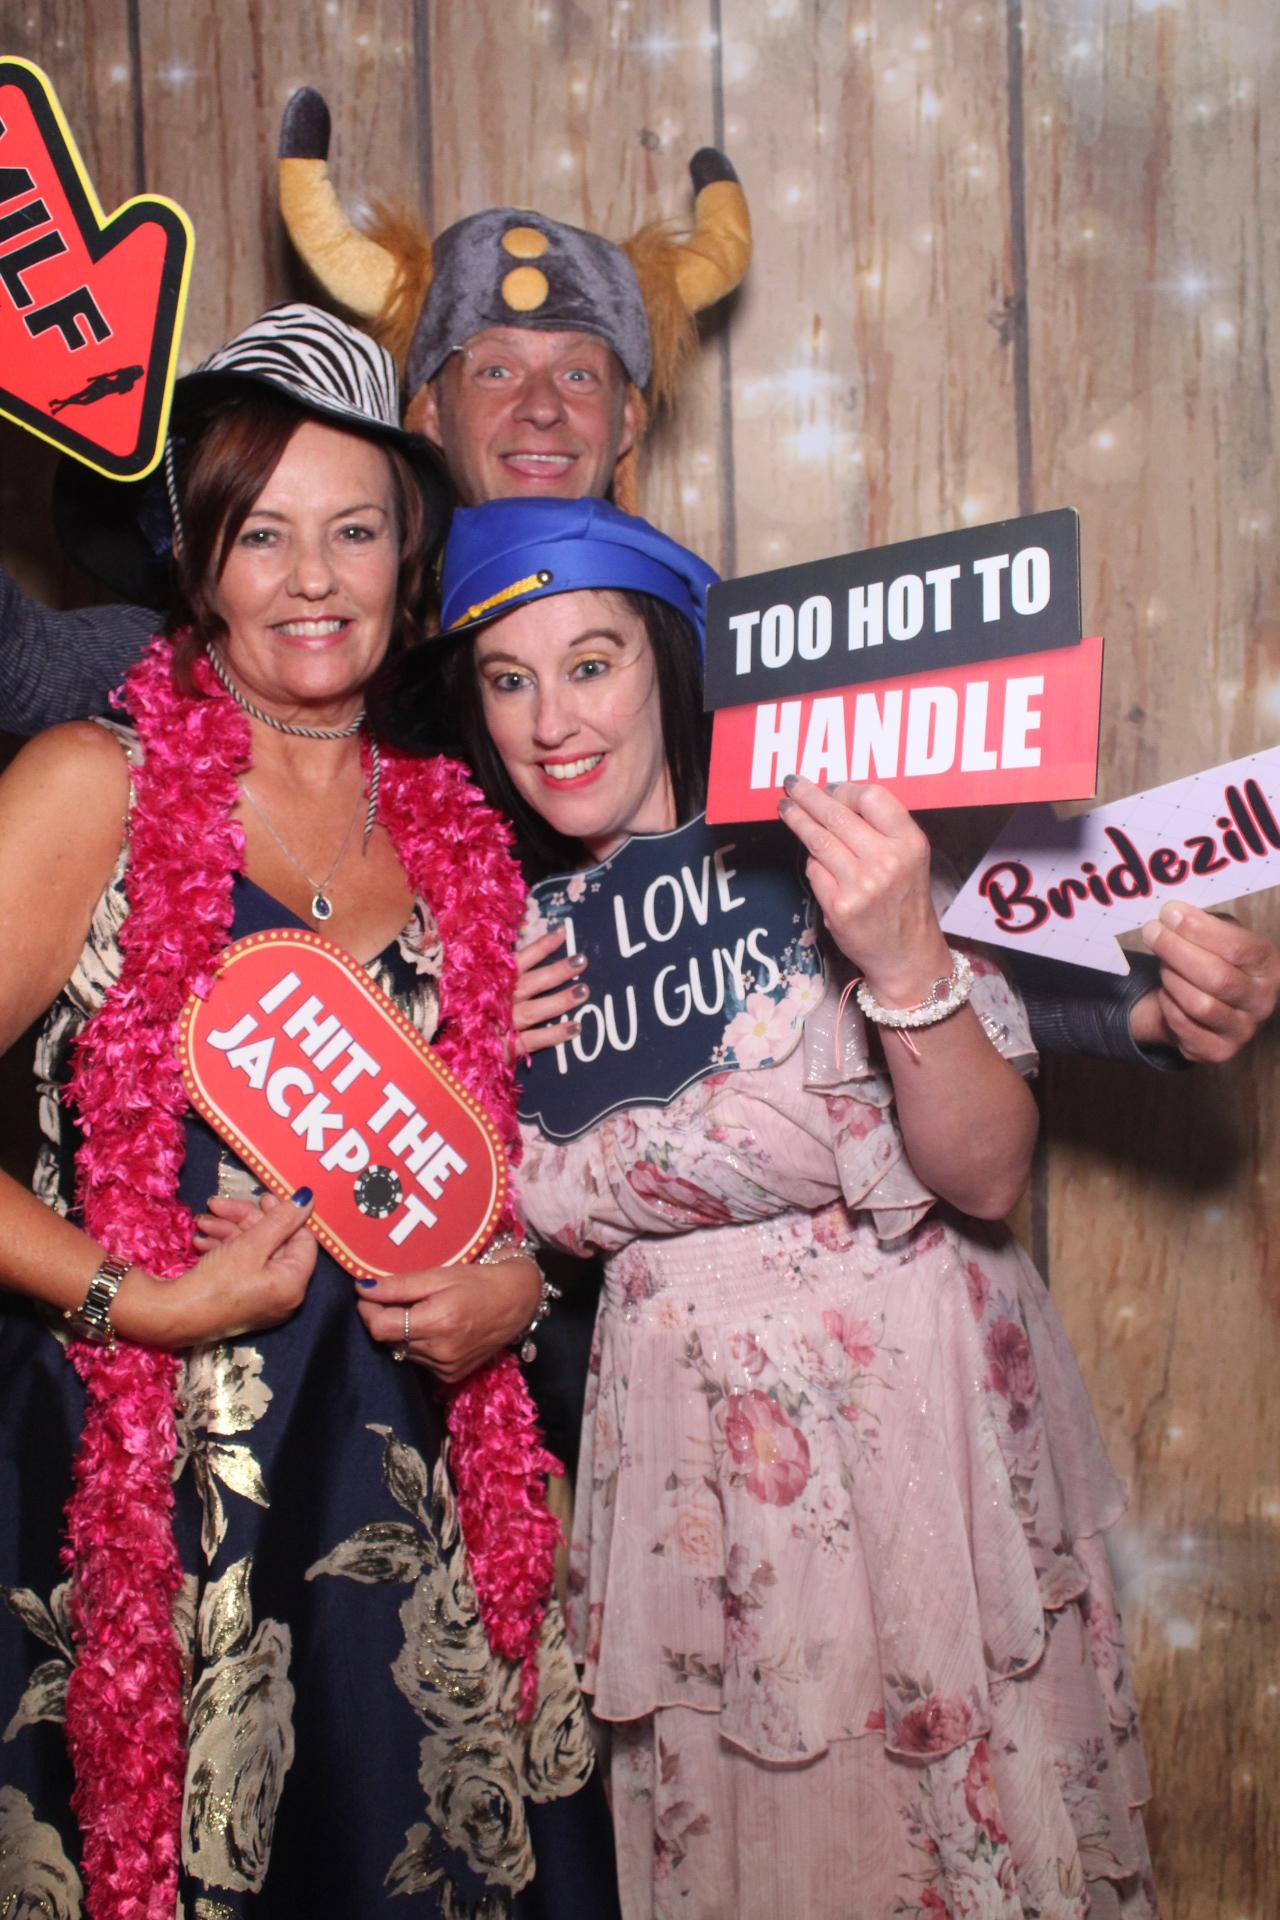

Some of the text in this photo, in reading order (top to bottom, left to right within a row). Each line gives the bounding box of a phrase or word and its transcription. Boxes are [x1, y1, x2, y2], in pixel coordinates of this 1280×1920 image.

[729, 547, 1050, 675] TOO HOT TO
[750, 675, 1044, 789] HANDLE
[565, 844, 745, 980] I LOVE
[654, 928, 781, 1026] GUYS
[258, 971, 468, 1200] I HIT THE
